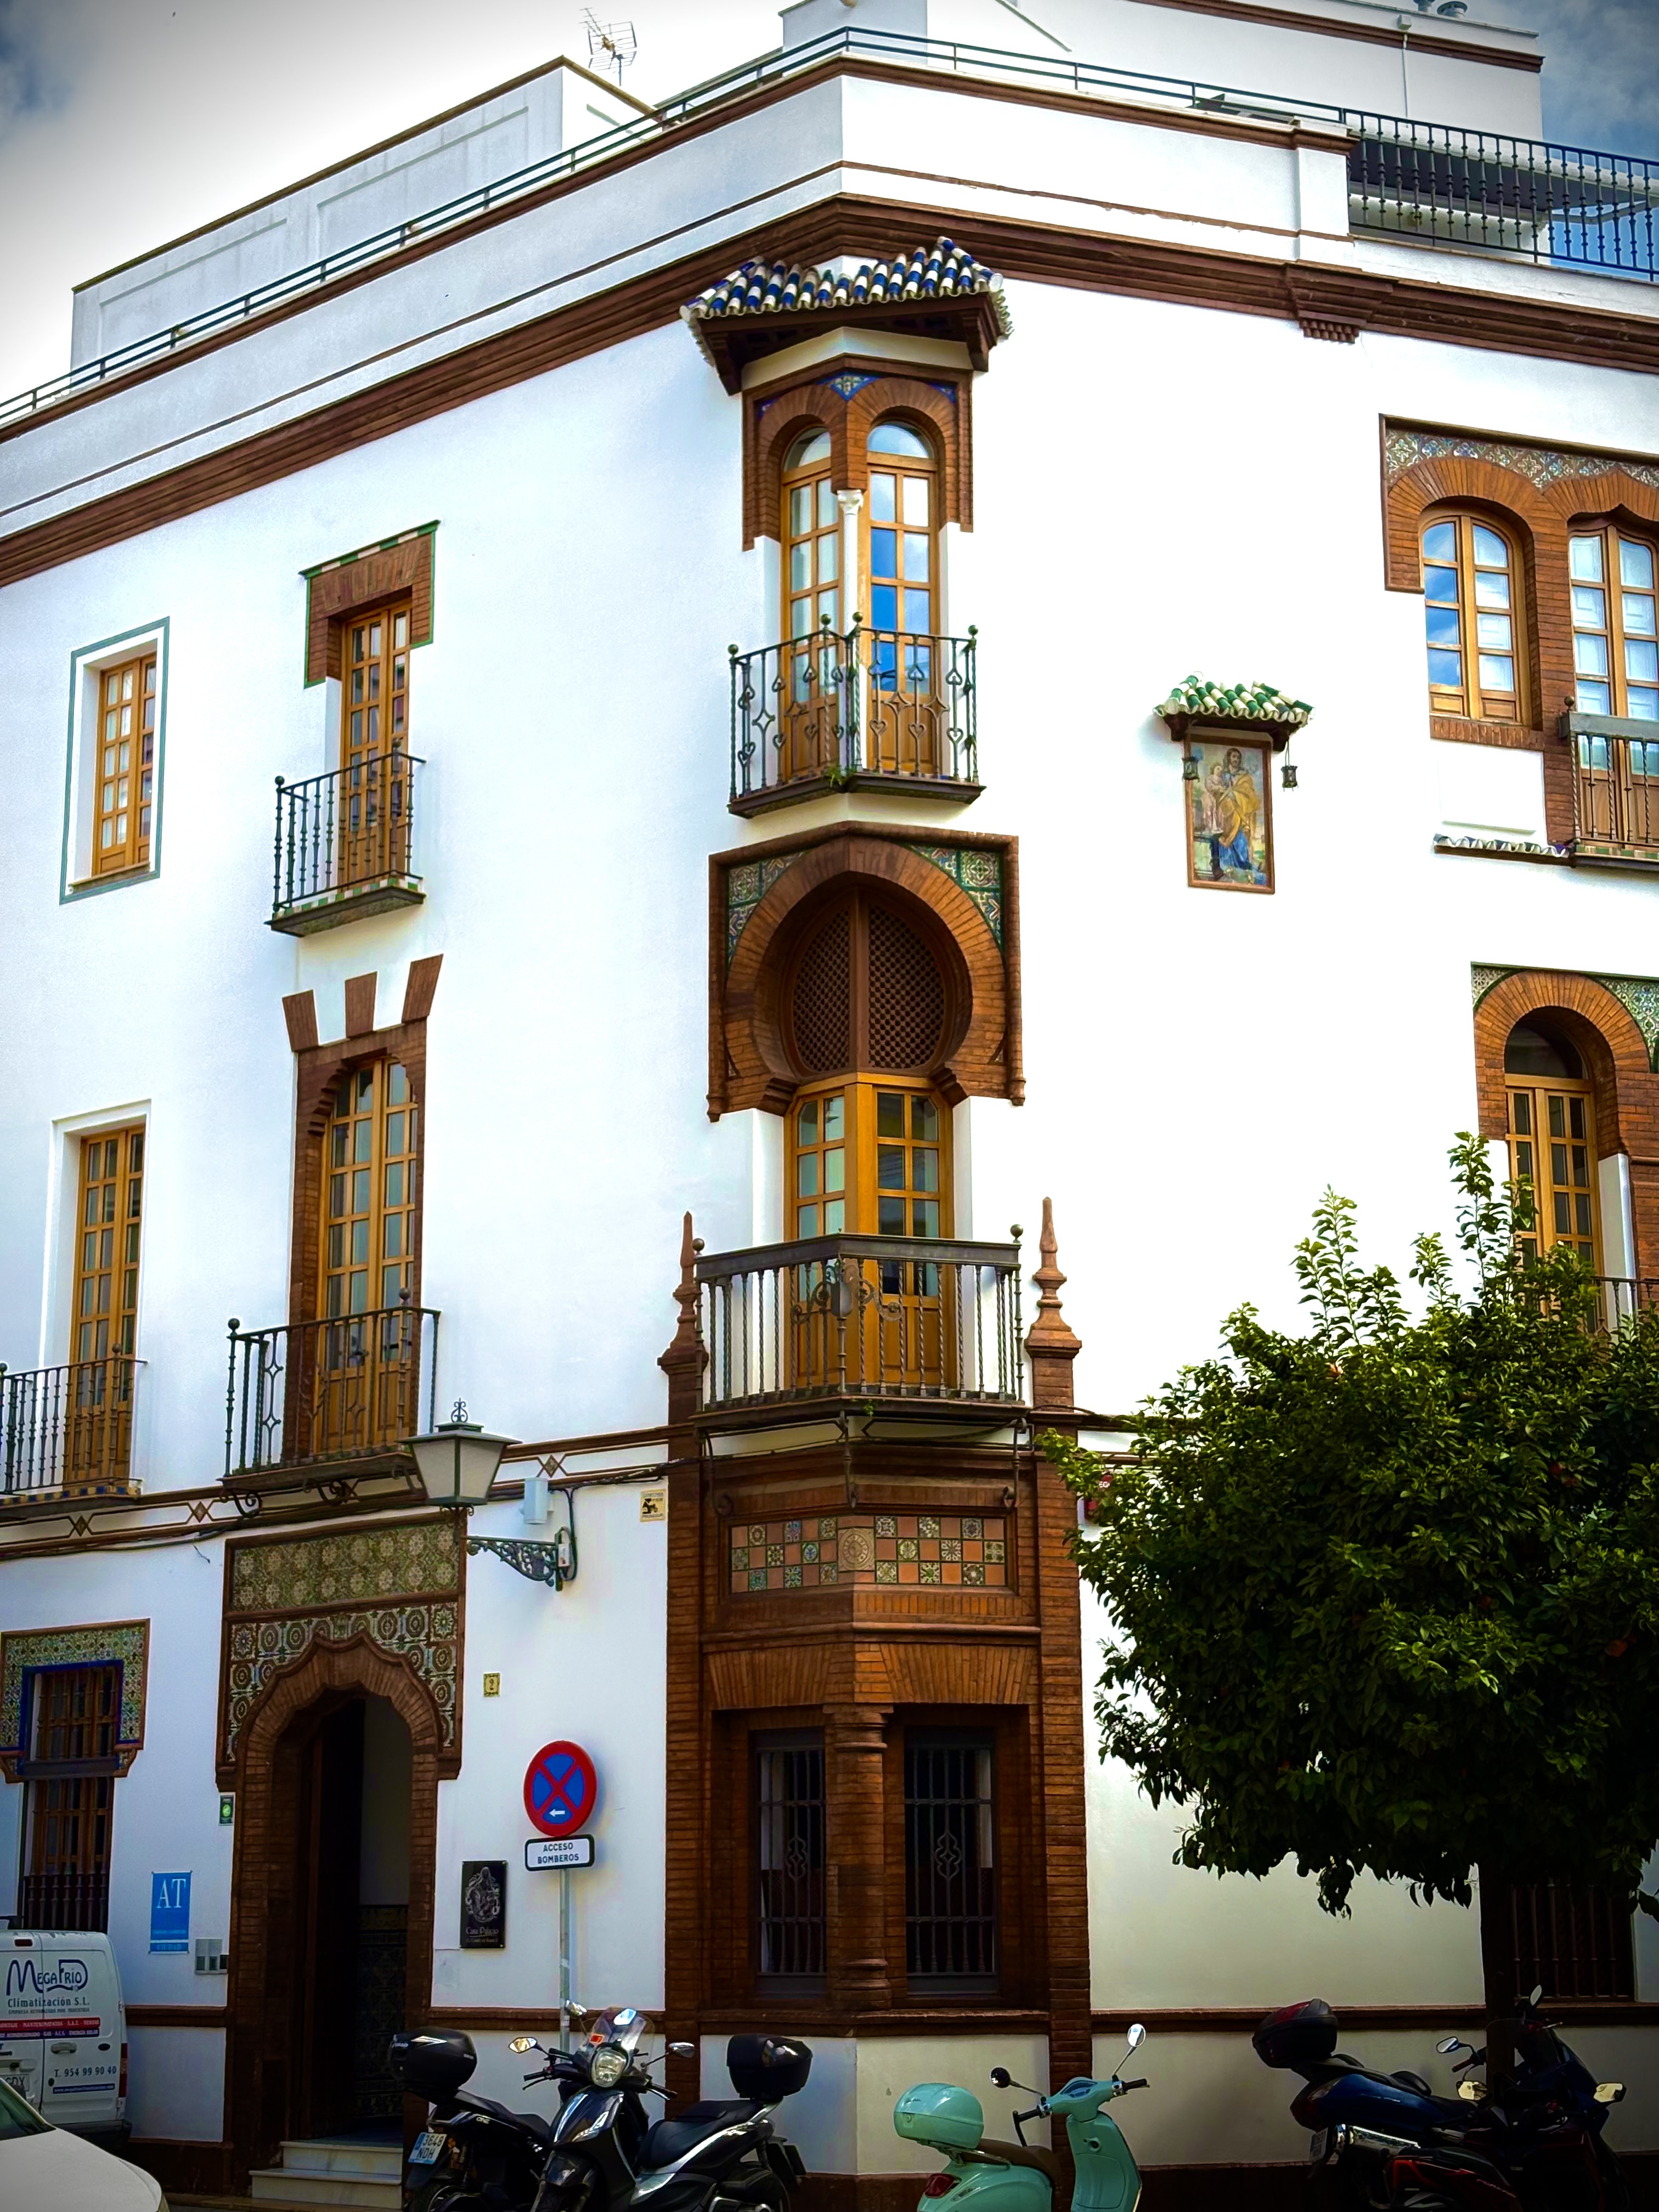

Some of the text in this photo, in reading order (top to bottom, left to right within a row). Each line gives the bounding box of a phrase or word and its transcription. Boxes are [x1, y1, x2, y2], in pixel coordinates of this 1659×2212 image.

[543, 1842, 573, 1852] ACCESO
[537, 1853, 579, 1864] BOMBEROS
[156, 1878, 186, 1909] AT
[8, 1996, 90, 2008] Climatización S.L.
[54, 2066, 117, 2078] T. 954 99 90 40
[422, 2135, 444, 2147] 3648
[416, 2147, 436, 2159] NDH
